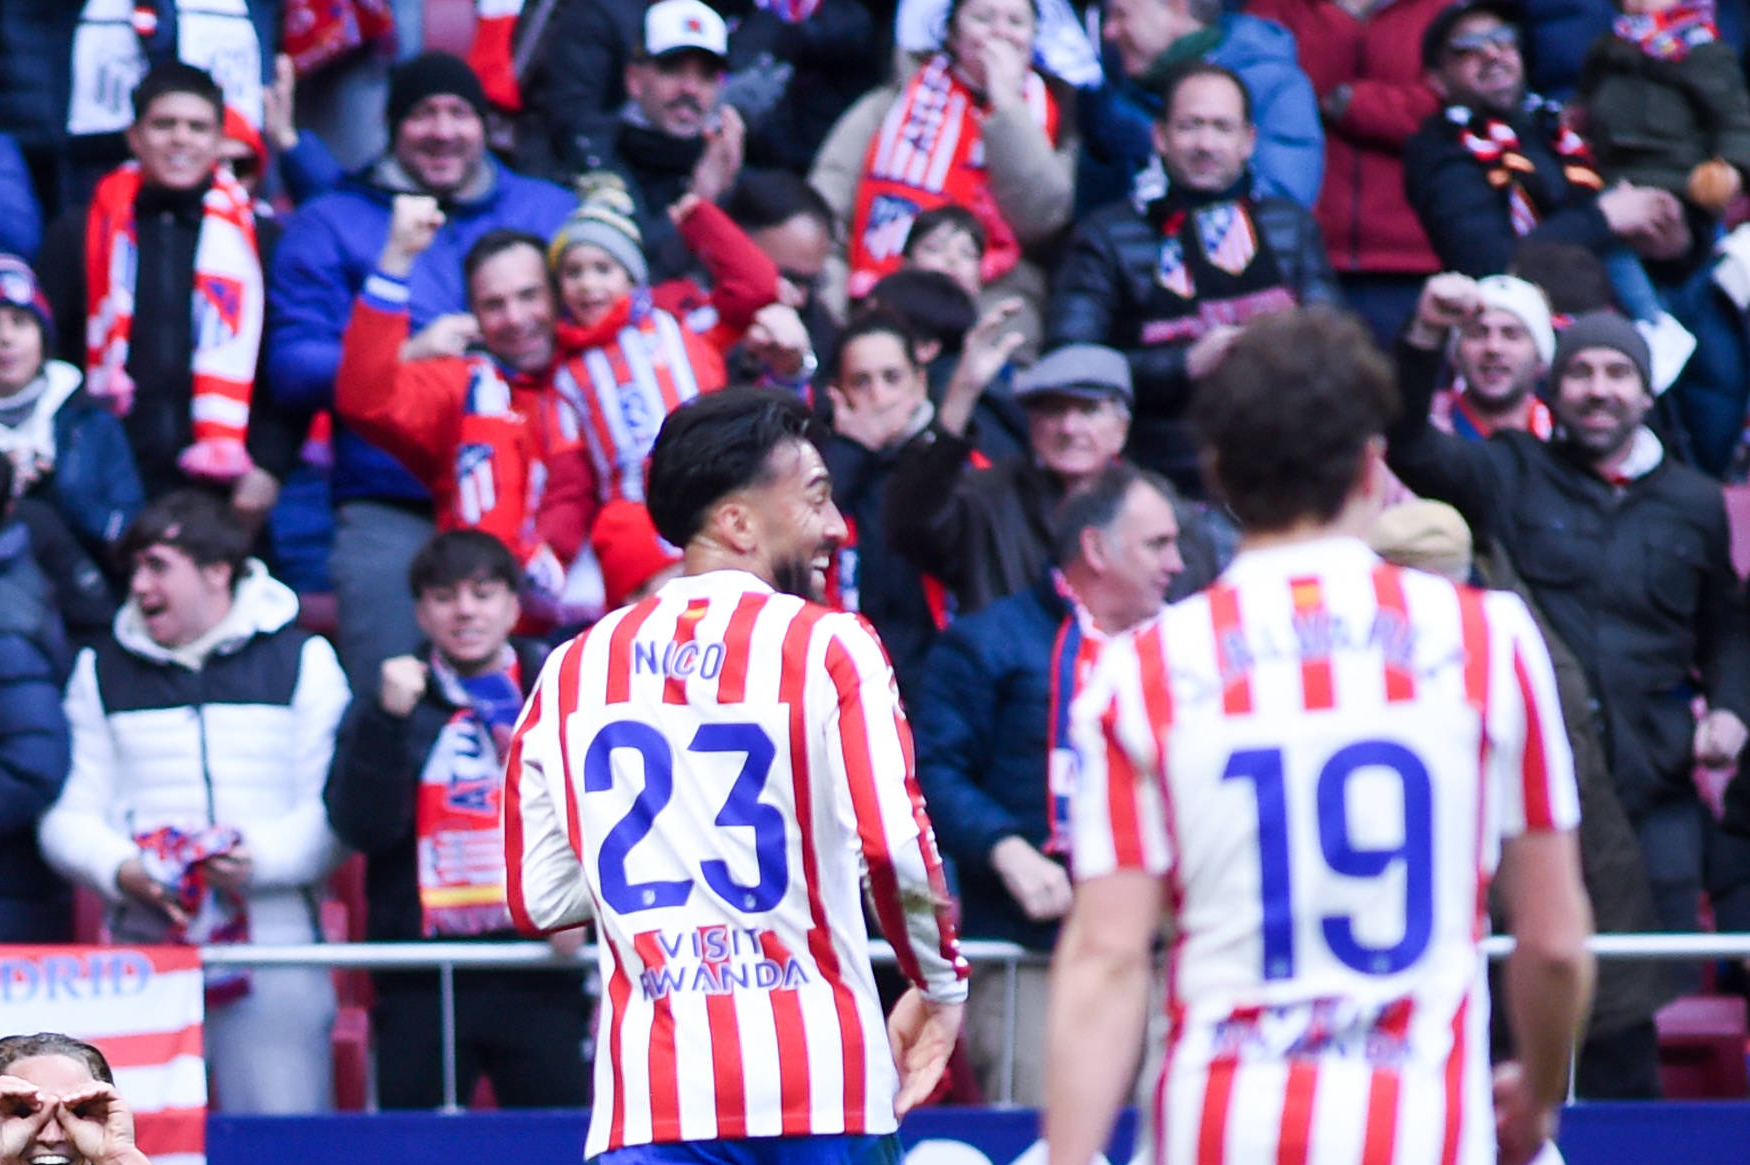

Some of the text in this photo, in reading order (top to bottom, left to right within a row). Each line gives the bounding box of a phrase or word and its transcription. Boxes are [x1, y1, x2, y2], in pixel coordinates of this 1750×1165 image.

[632, 640, 726, 681] NICO
[584, 719, 789, 916] 23
[1222, 740, 1433, 981] 19
[657, 927, 761, 963] VISIT
[639, 959, 809, 1002] RWANDA
